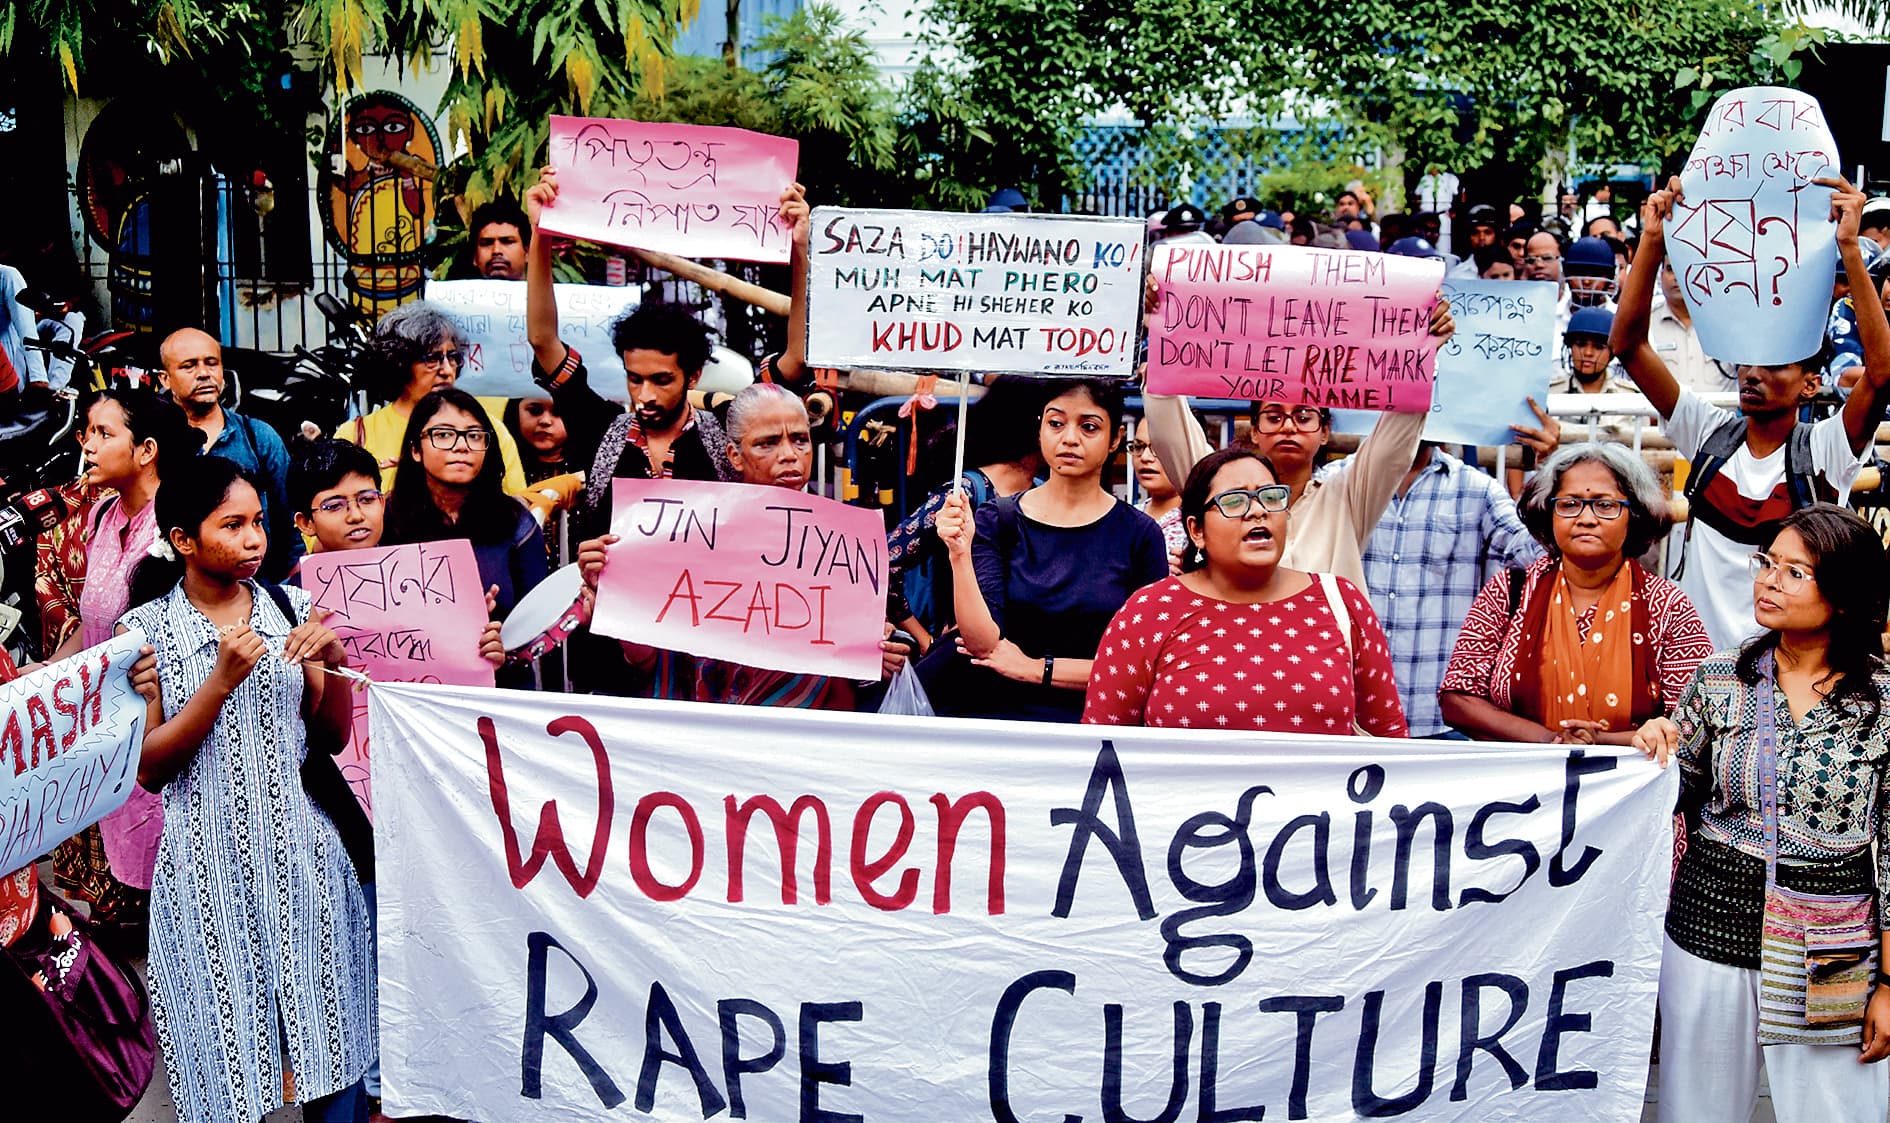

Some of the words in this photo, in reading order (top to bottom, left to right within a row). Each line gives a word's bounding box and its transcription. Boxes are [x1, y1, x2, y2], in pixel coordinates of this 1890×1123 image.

[1755, 99, 1820, 131] বার
[818, 216, 905, 259] SAZA
[967, 231, 1080, 266] HAYWANO
[1092, 240, 1139, 272] KO!
[835, 268, 899, 291] MUH
[920, 268, 983, 290] MAT
[1165, 247, 1273, 284] PUNISH
[1306, 252, 1386, 287] THEM
[867, 294, 938, 313] APNE
[953, 297, 973, 312] HI
[980, 295, 1055, 315] SHEHER
[1067, 300, 1093, 317] KO
[1163, 291, 1253, 335] DON'T
[1267, 295, 1350, 338] LEAVE
[1364, 295, 1435, 339] THEM
[871, 320, 963, 353] KHUD
[973, 326, 1030, 350] MAT
[1039, 327, 1128, 362] TODO!
[1160, 337, 1234, 369] DON'T
[1244, 343, 1295, 375] LET
[1302, 344, 1360, 386] RAPE
[1365, 348, 1431, 384] MARK
[1220, 375, 1288, 400] YOUR
[1301, 386, 1397, 411] NAME!
[27, 489, 46, 506] 18
[40, 510, 57, 528] 18
[638, 498, 718, 551] JIN
[761, 506, 879, 595] JIYAN
[655, 568, 836, 645] AZADI
[477, 715, 1005, 915] Women
[1050, 740, 1617, 986] Against
[520, 932, 863, 1123] RAPE
[988, 961, 1615, 1123] CULTURE
